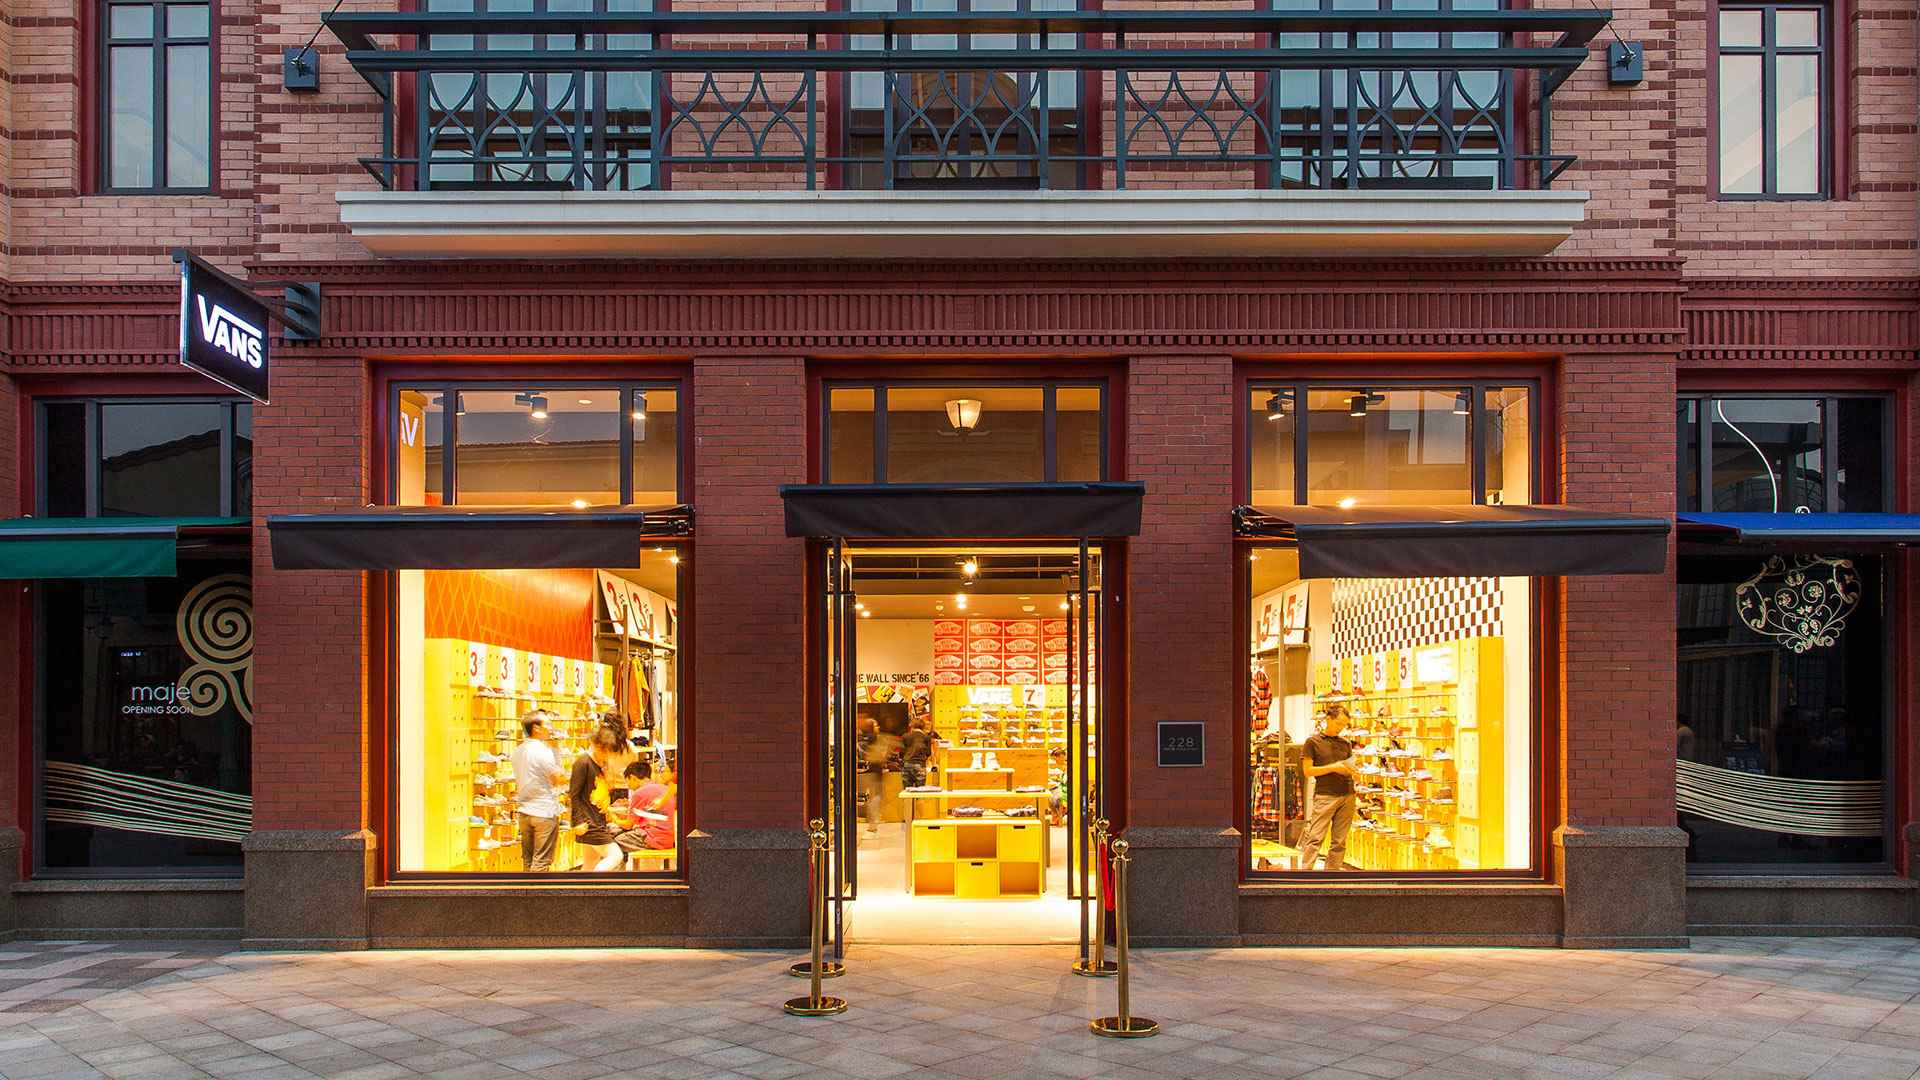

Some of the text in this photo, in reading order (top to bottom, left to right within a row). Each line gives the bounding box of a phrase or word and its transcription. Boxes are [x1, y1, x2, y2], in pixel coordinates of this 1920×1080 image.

[197, 293, 263, 369] VANS
[1262, 603, 1272, 642] 5
[1286, 594, 1296, 636] 5
[470, 651, 478, 677] 3
[501, 656, 508, 680] 3
[528, 661, 535, 683] 3
[552, 664, 559, 685] 3
[1353, 664, 1359, 685] 5
[1375, 661, 1381, 682] 5
[1400, 657, 1407, 680] 5
[575, 667, 580, 687] 3
[594, 670, 600, 689] 3
[866, 673, 890, 683] WALL
[1332, 667, 1338, 687] 5
[131, 682, 191, 704] maje
[967, 687, 1013, 705] VANS
[1025, 690, 1035, 702] 7
[122, 705, 194, 715] OPENING SOON
[1168, 736, 1194, 747] 228
